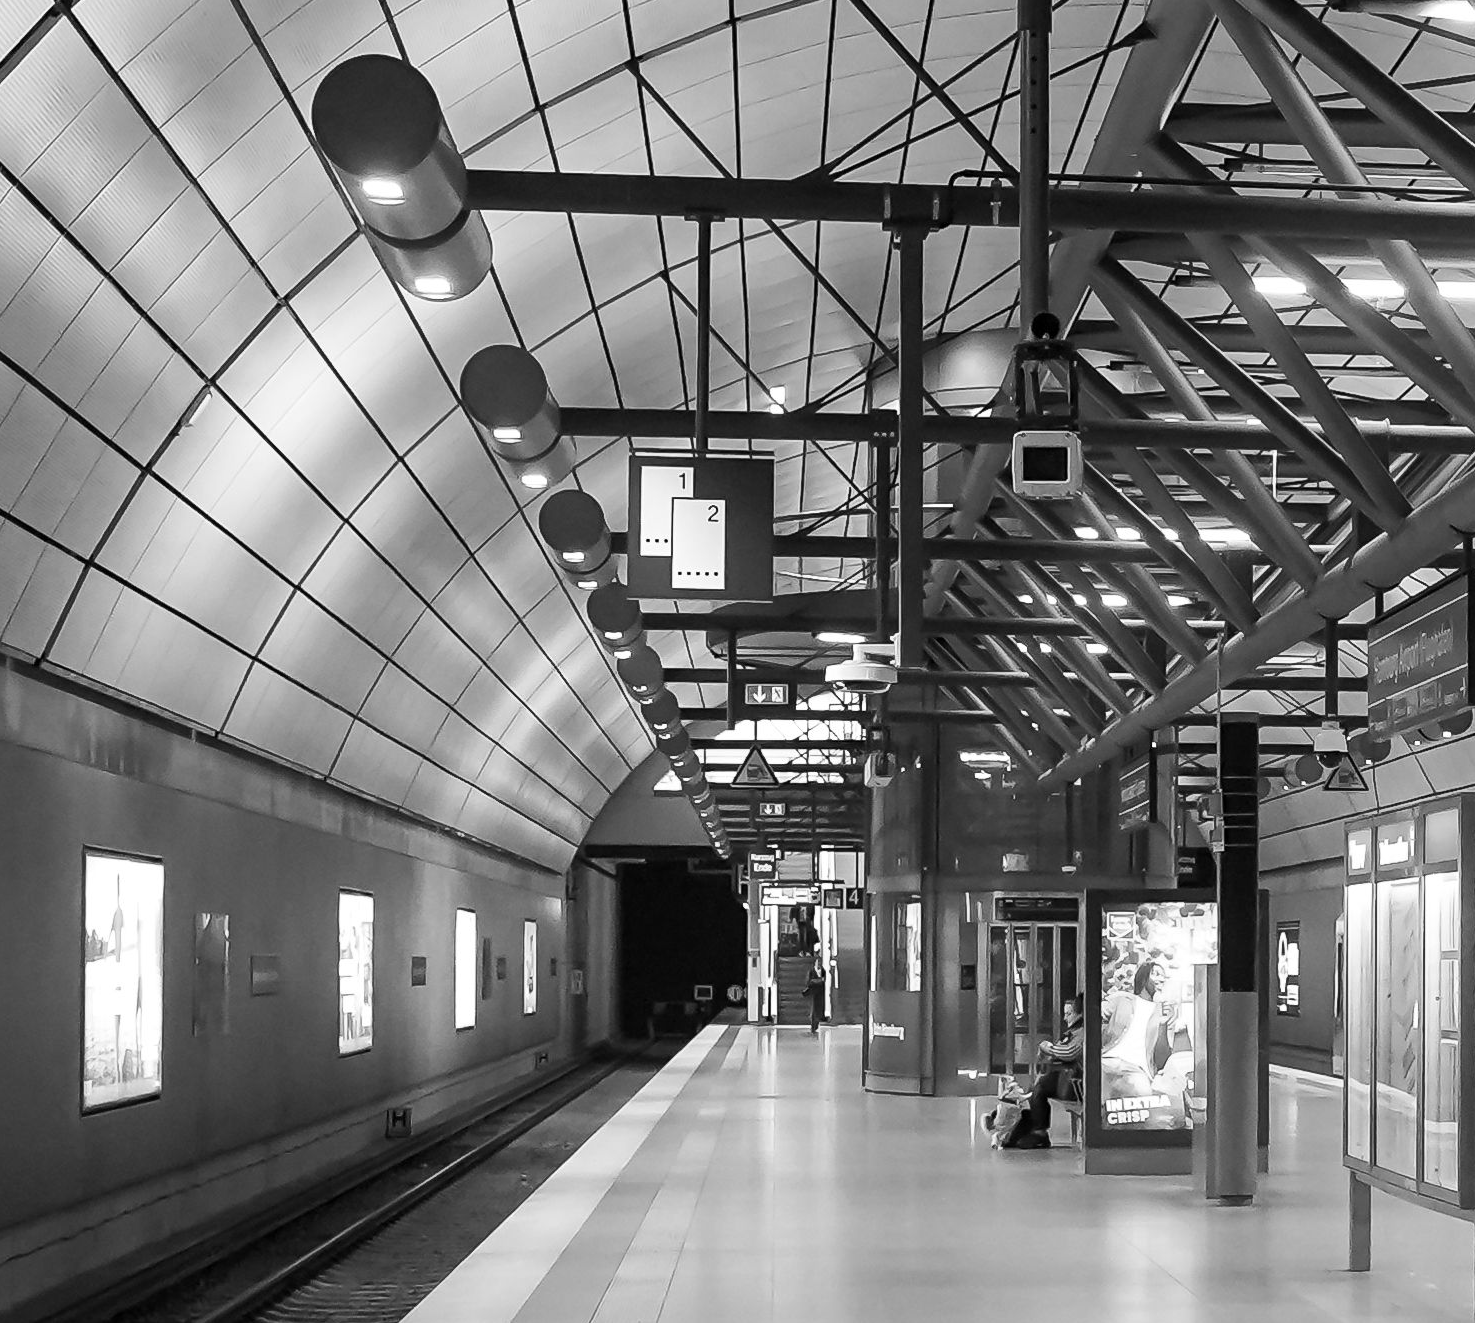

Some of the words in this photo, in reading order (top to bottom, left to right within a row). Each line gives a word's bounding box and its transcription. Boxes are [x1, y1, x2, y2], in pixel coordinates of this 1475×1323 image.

[678, 472, 686, 490] 1
[707, 505, 720, 523] 2
[848, 889, 860, 905] 4
[1107, 1109, 1150, 1125] CRISP
